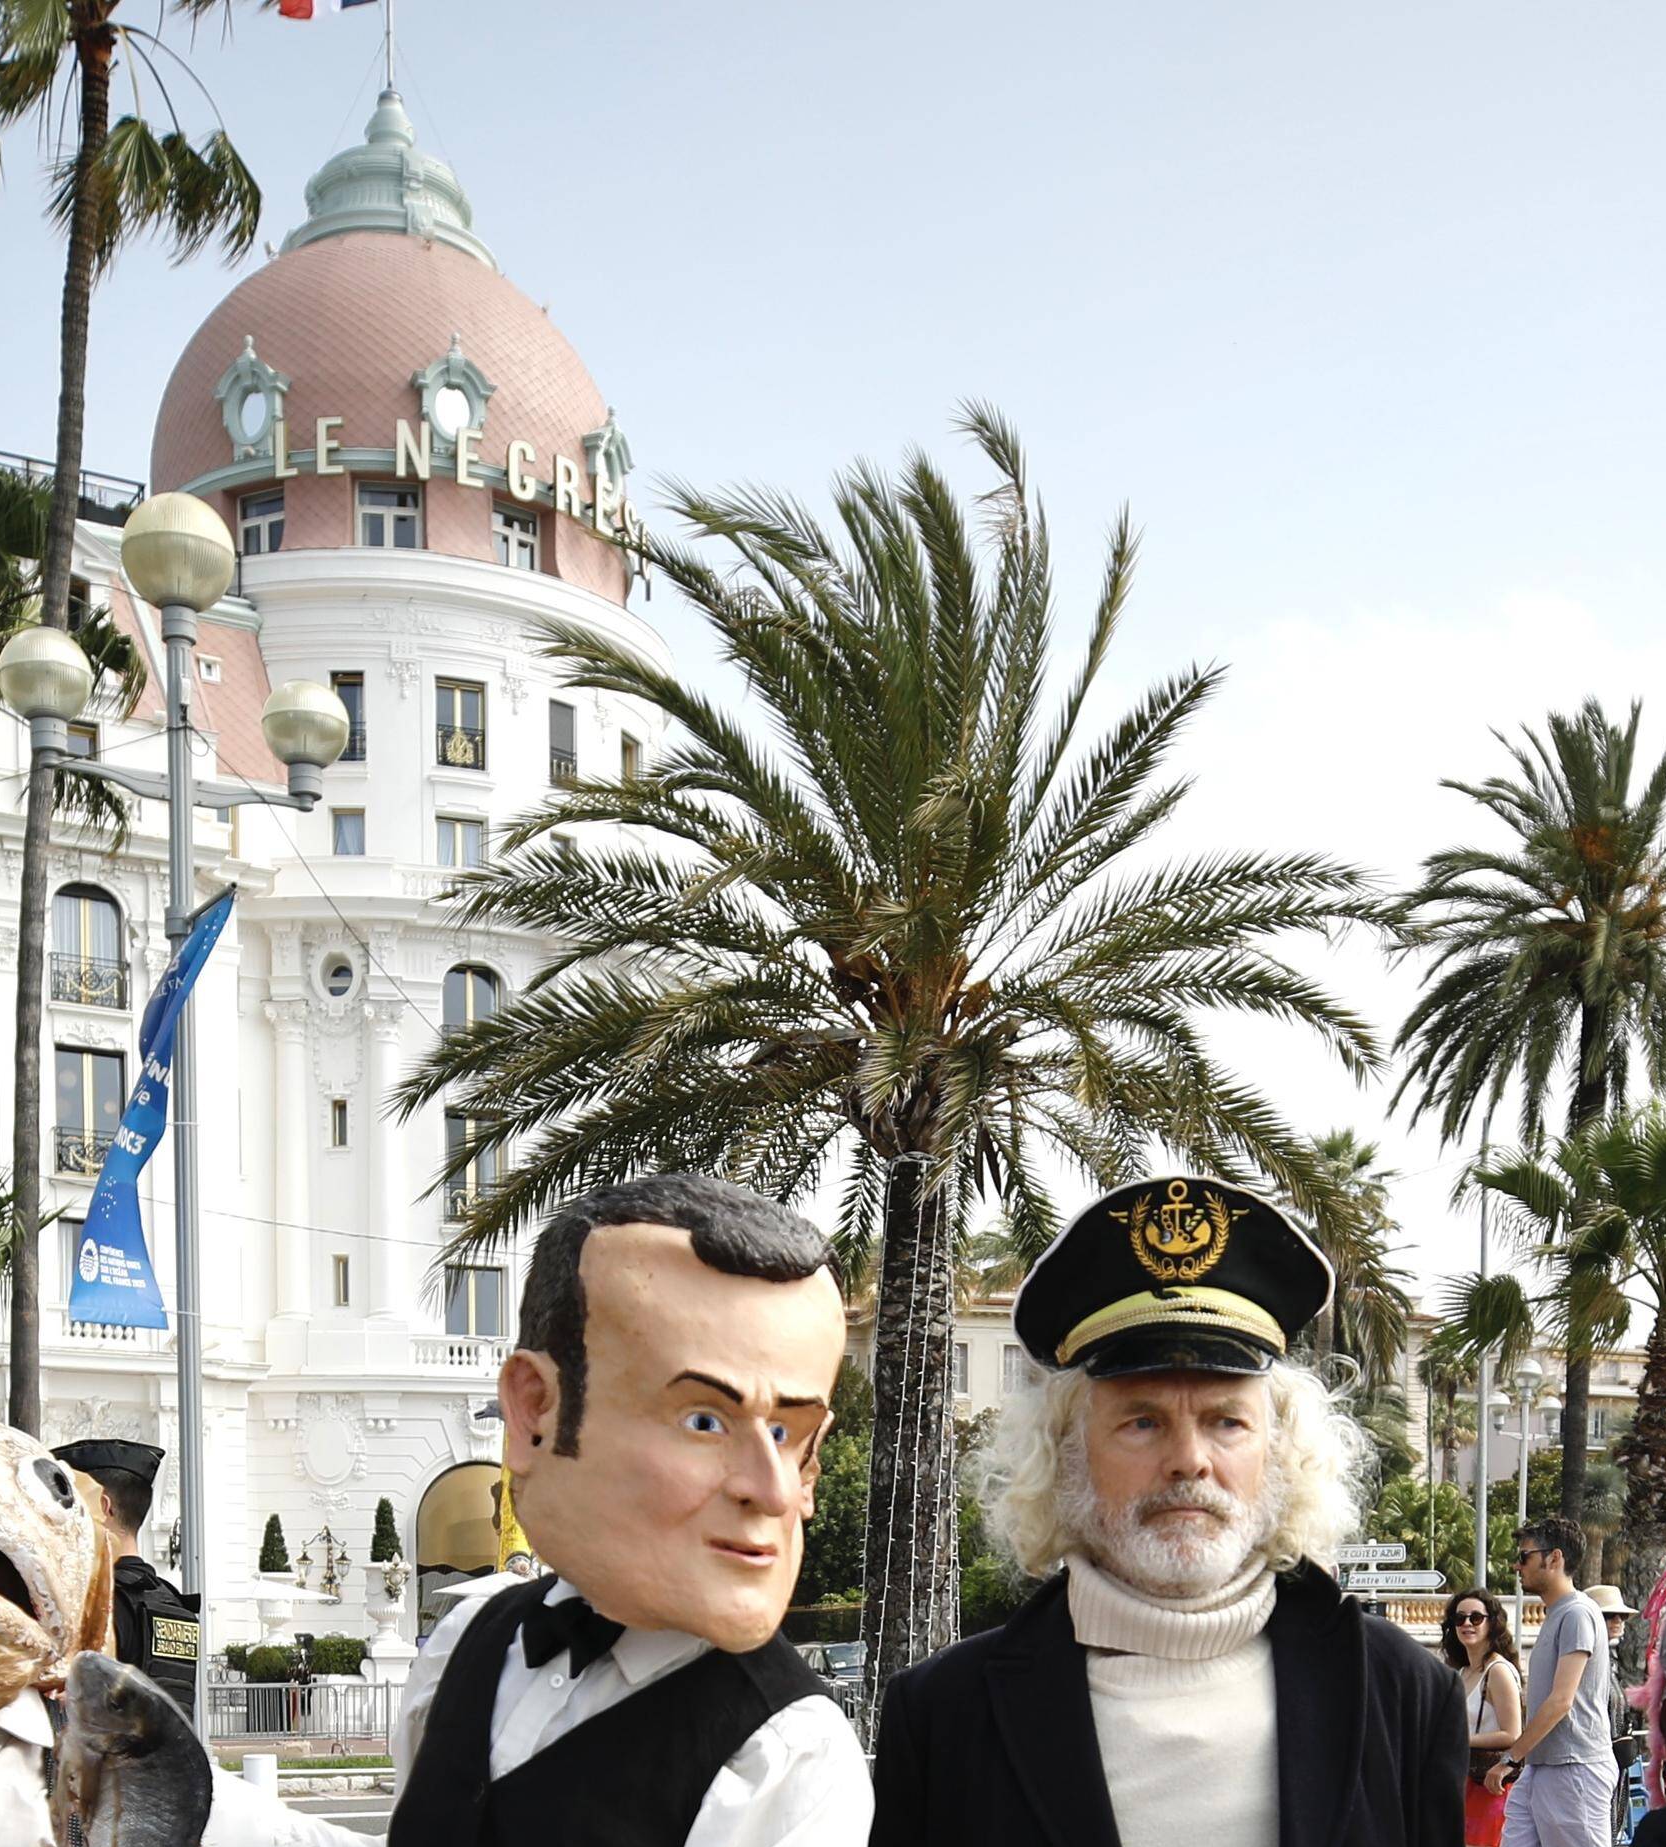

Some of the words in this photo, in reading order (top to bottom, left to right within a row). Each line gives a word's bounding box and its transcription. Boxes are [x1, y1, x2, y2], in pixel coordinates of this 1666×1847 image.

[274, 415, 344, 478] LE
[1348, 1576, 1380, 1585] Centre
[1384, 1575, 1407, 1584] Ville
